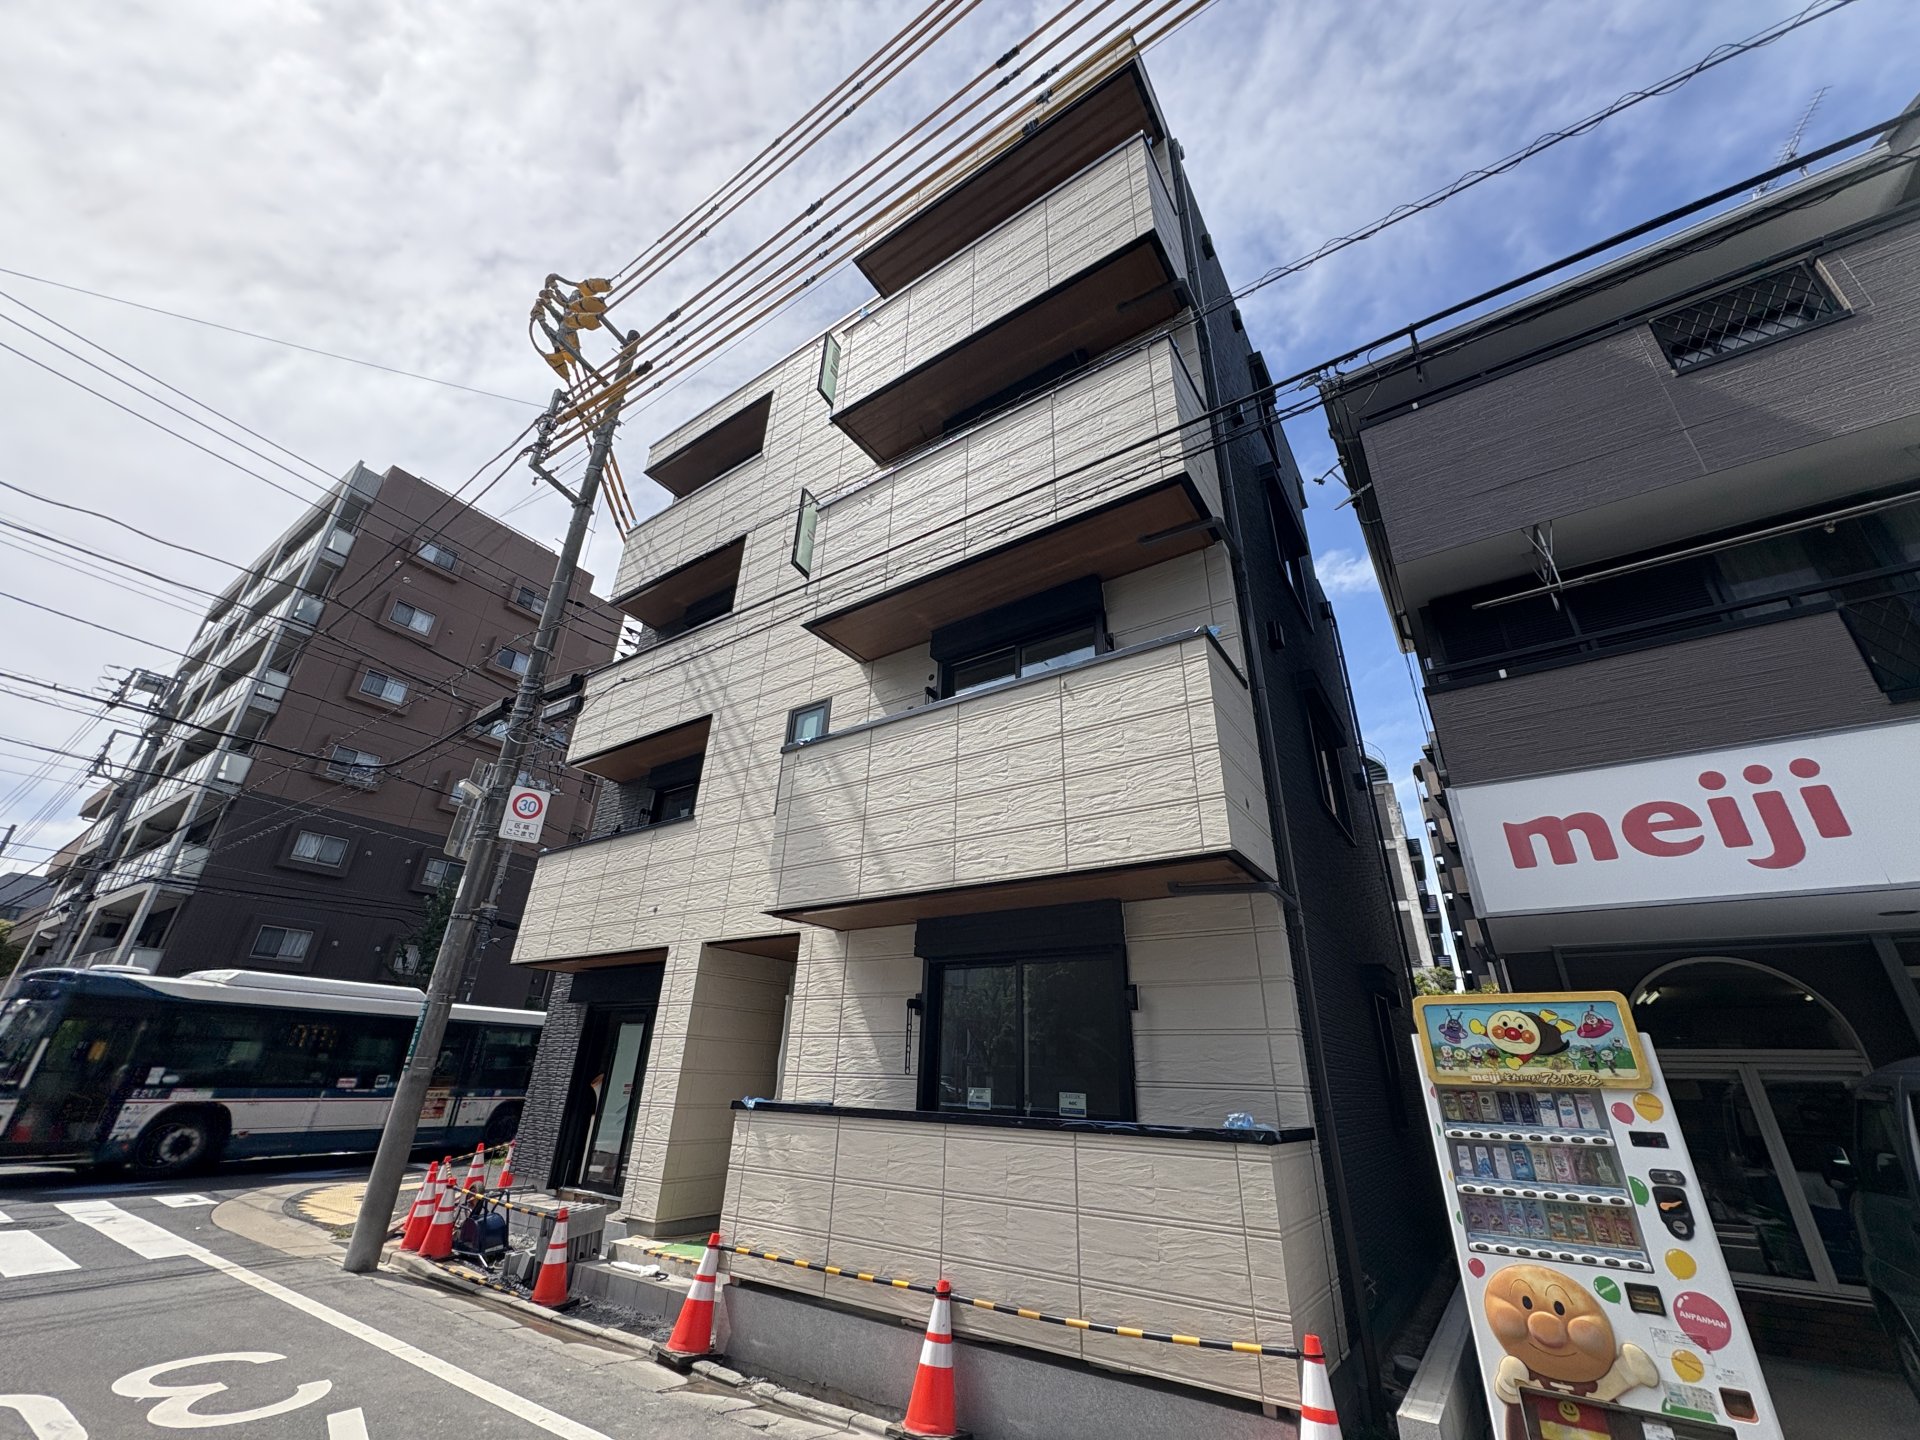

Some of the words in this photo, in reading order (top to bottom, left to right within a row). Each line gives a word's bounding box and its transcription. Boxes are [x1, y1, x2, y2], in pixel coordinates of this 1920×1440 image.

[518, 799, 537, 813] 30
[1502, 757, 1852, 870] meiji
[506, 828, 535, 839] ここまで
[1471, 1073, 1501, 1084] meiji
[1679, 1310, 1727, 1329] ANPANMAN
